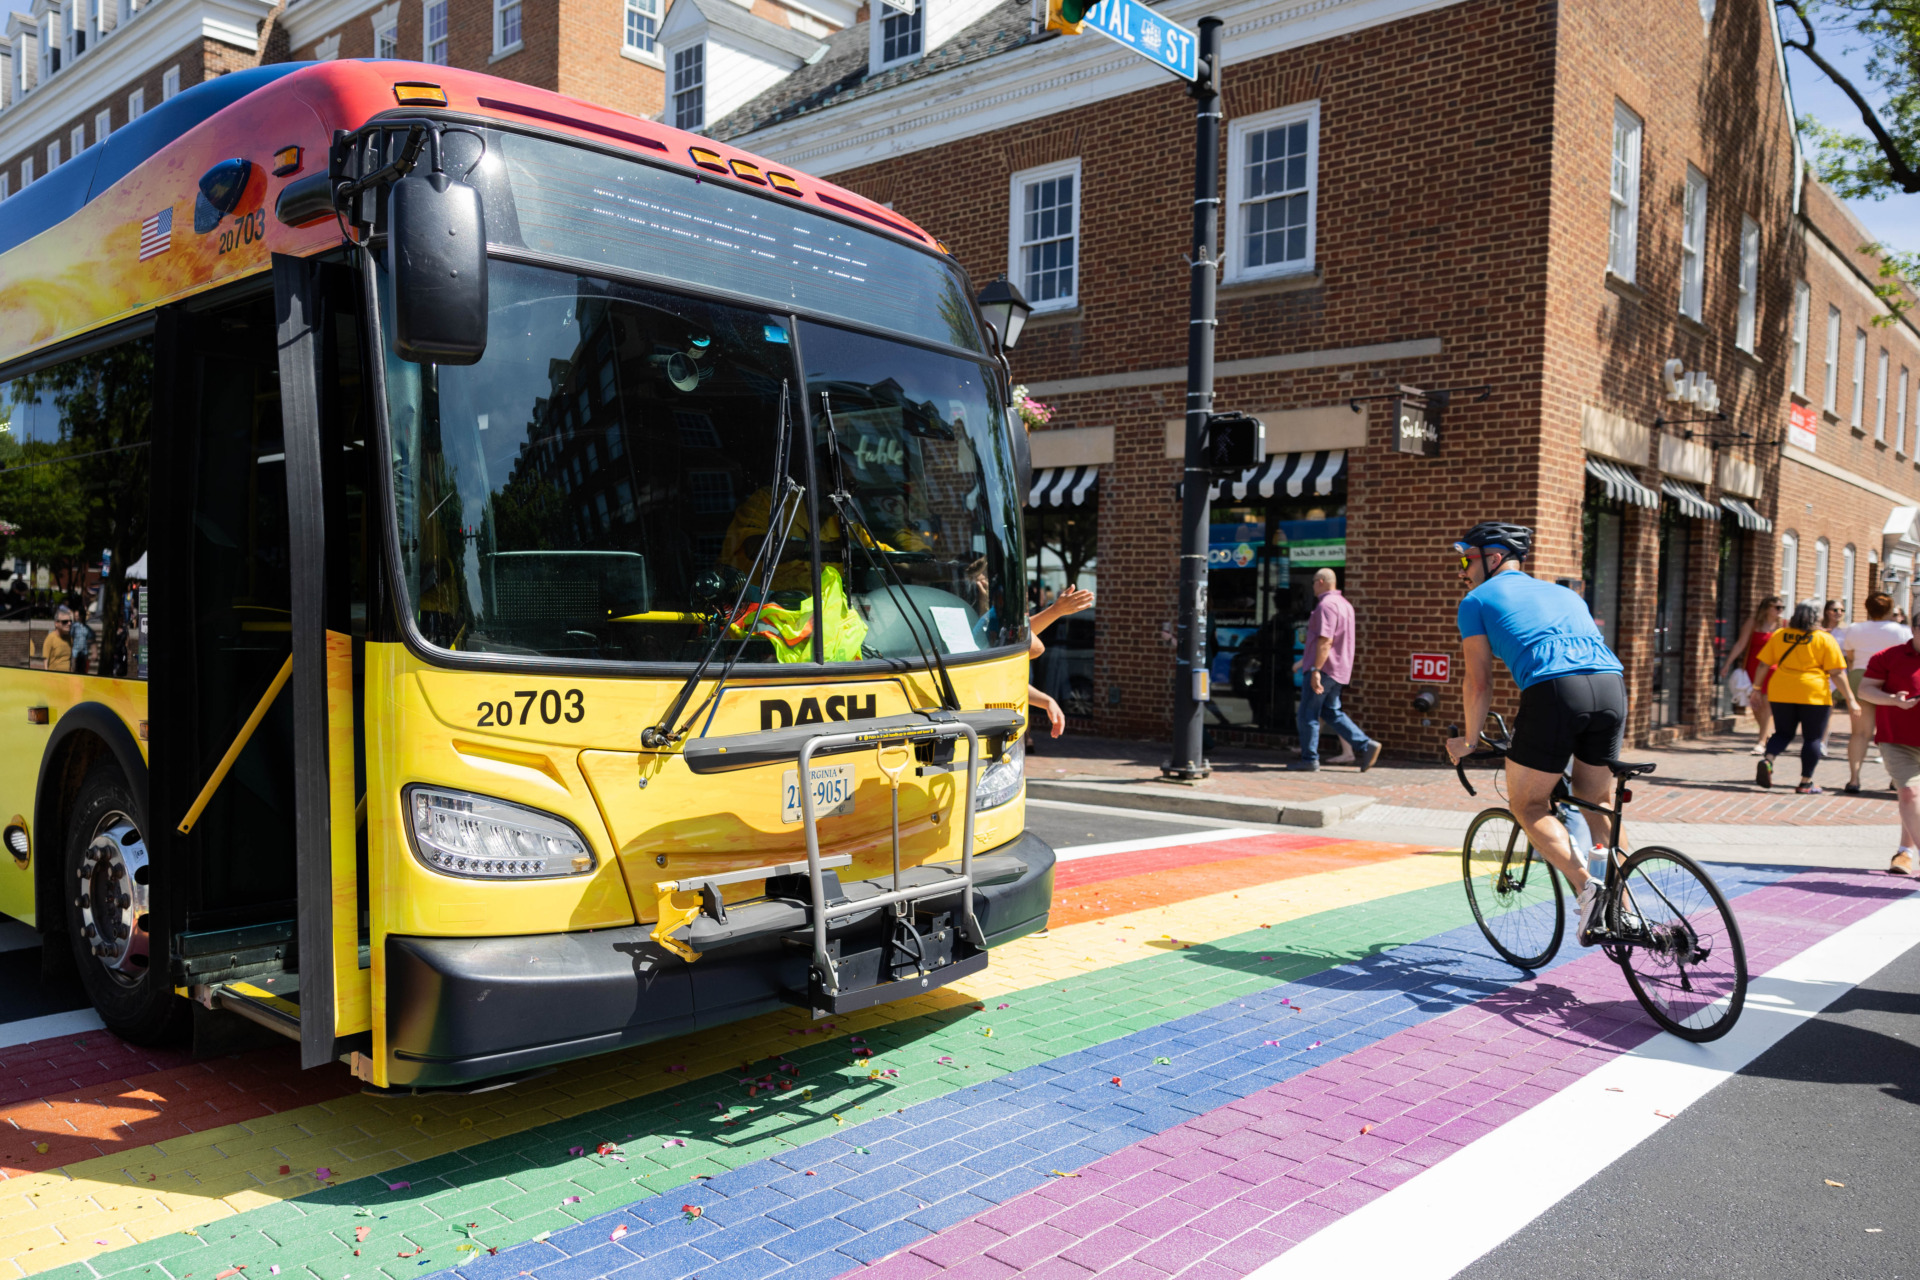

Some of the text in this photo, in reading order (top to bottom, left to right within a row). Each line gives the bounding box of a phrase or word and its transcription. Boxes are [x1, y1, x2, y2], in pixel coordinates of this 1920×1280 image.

[1086, 0, 1190, 70] YAL ST
[219, 207, 265, 255] 20703
[1413, 659, 1447, 677] FDC
[477, 688, 585, 727] 20703
[760, 694, 876, 730] DASH
[809, 768, 837, 780] RGINIA
[787, 778, 851, 809] 21-905L
